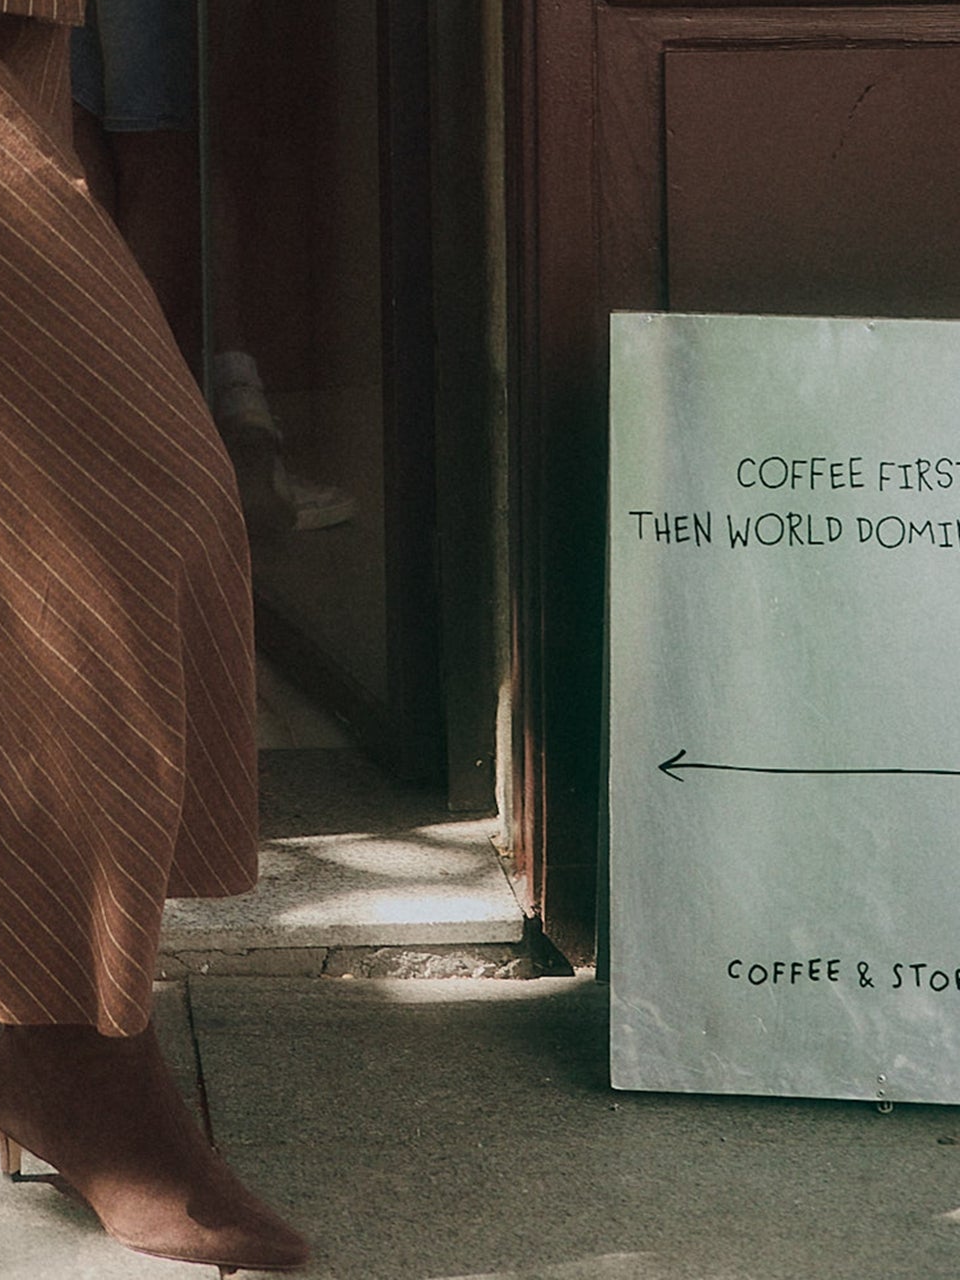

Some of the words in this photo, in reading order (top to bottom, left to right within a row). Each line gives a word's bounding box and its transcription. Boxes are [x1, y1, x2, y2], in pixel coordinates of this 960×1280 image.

[737, 456, 865, 490] COFFEE
[628, 510, 712, 547] THEN
[726, 511, 842, 548] WORLD
[856, 515, 960, 548] DOMI
[727, 958, 841, 986] COFFEE
[856, 961, 875, 988] &
